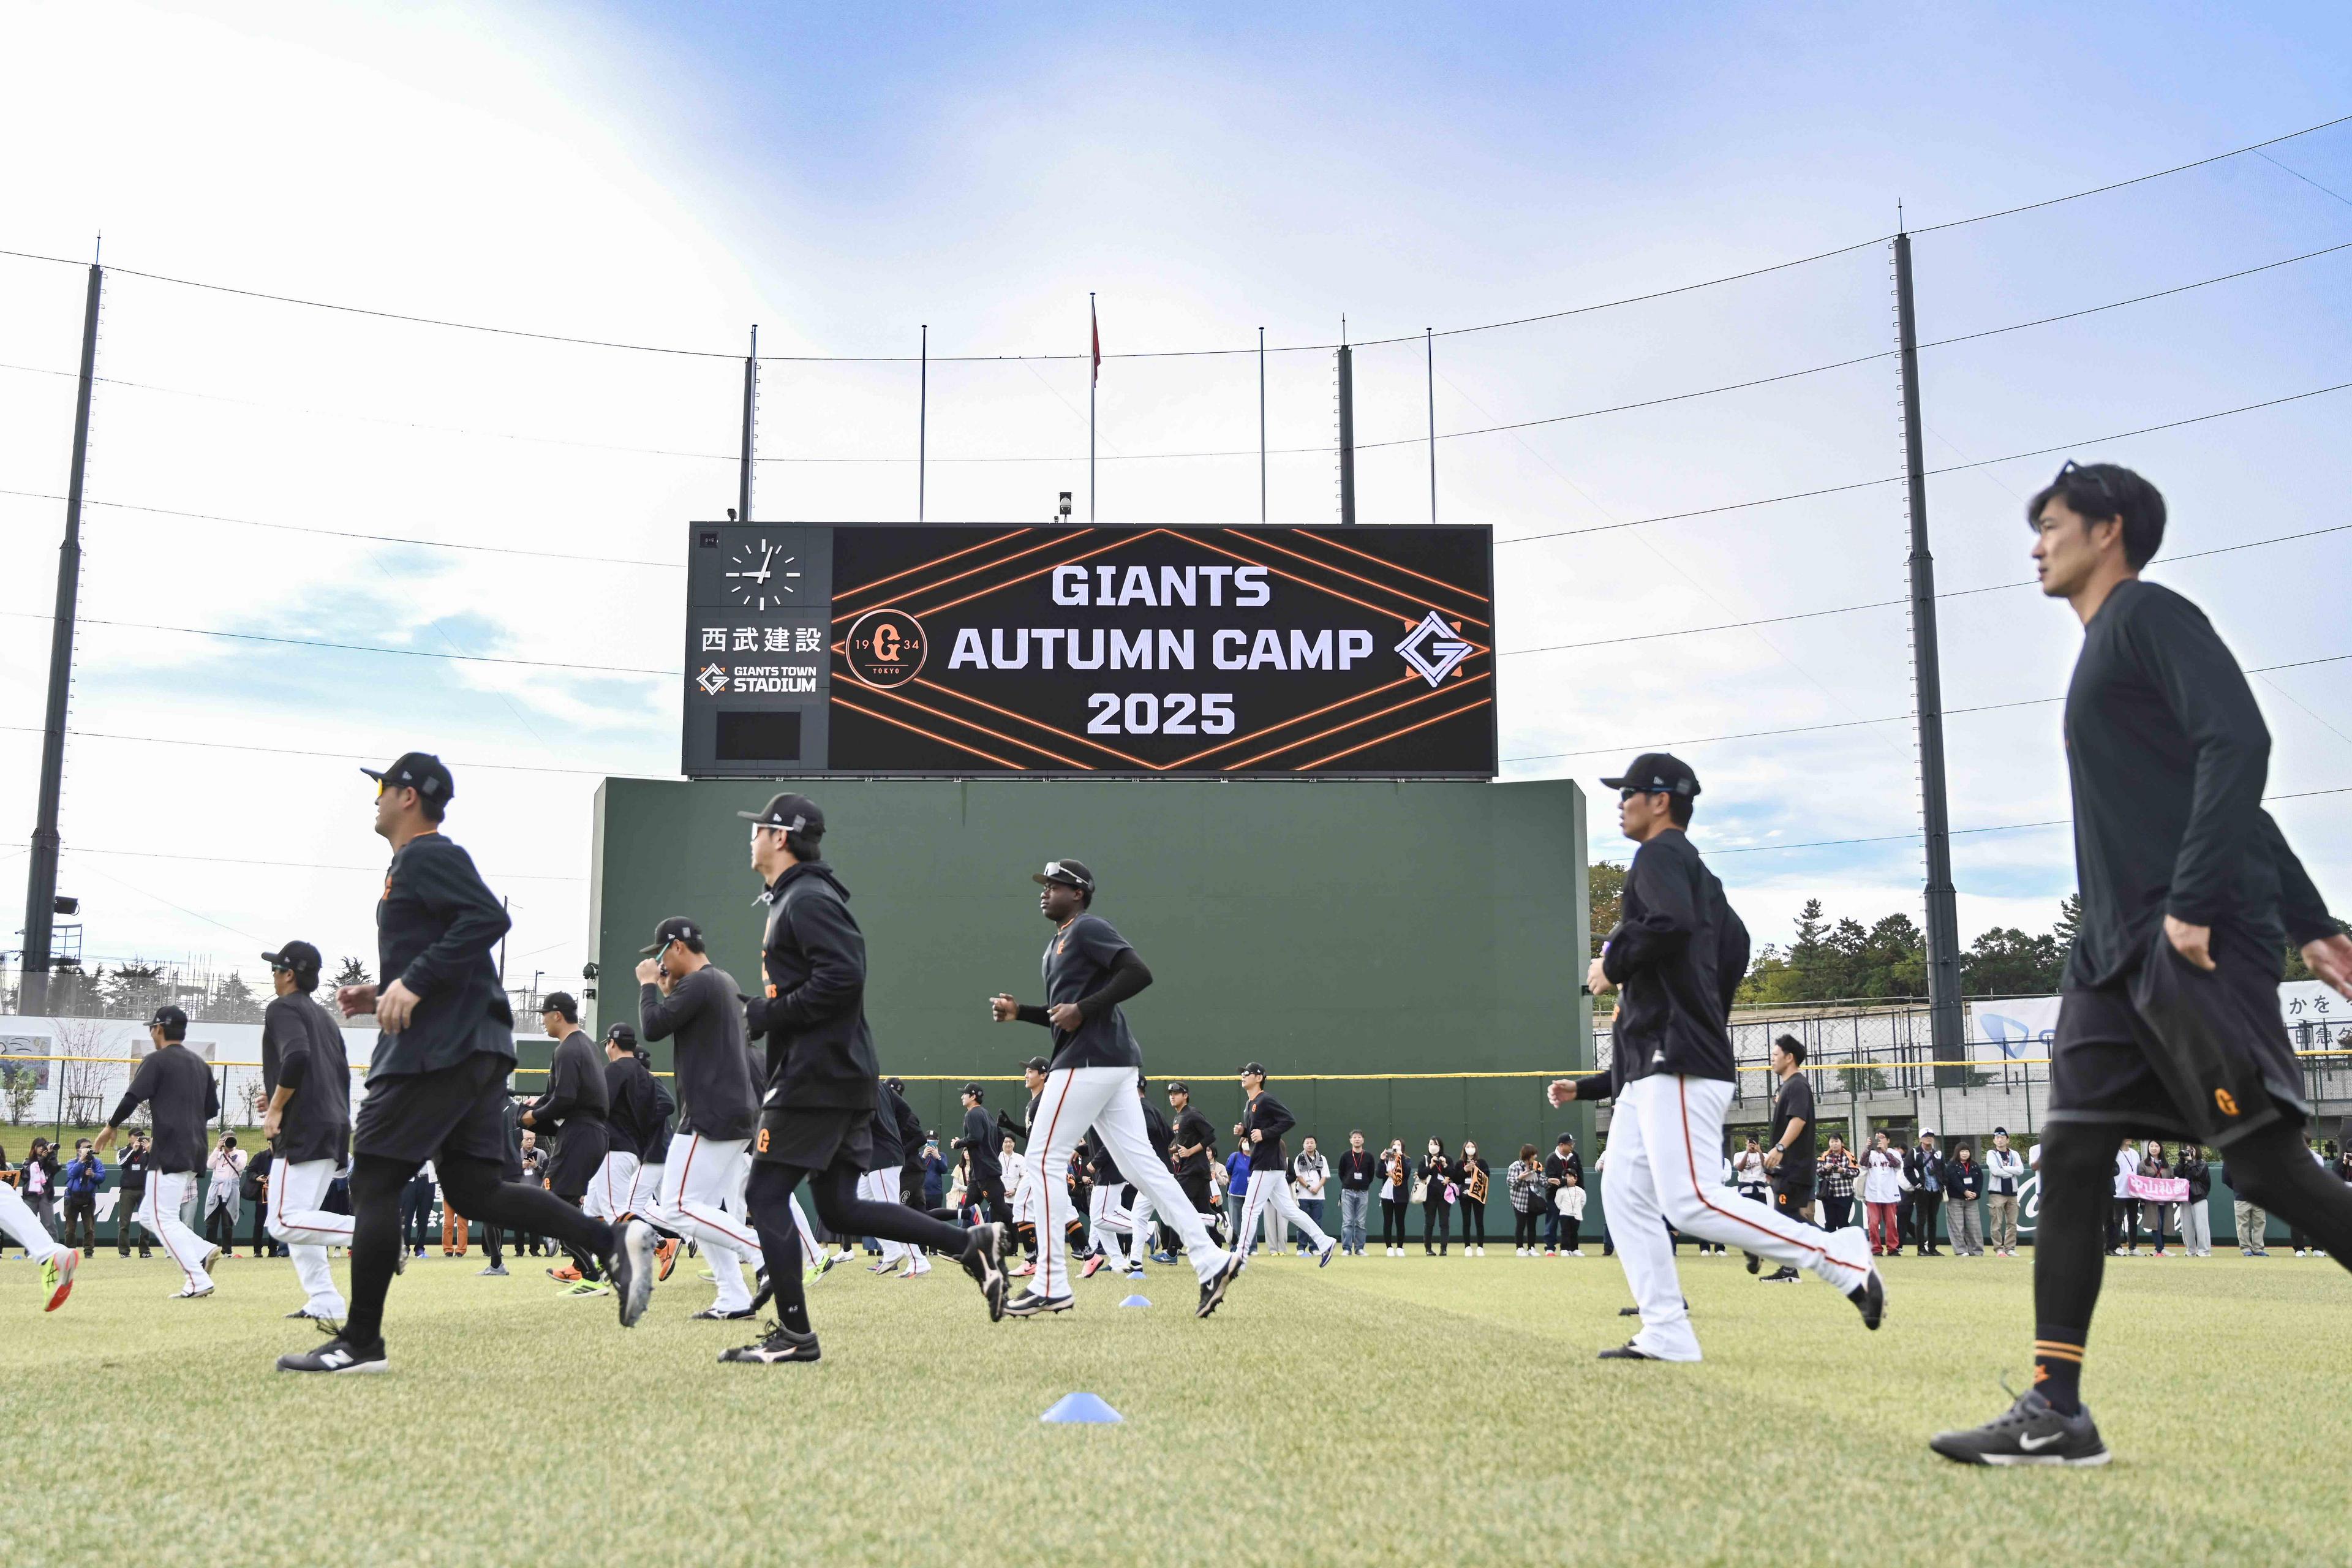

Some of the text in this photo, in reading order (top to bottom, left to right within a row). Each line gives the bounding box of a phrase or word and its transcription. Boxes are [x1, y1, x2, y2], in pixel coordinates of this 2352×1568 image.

[1052, 565, 1270, 606] GIANTS
[702, 627, 821, 652] 西武建設
[856, 640, 919, 649] 19 34
[872, 624, 900, 662] G
[948, 628, 1373, 671] AUTUMN CAMP
[734, 666, 816, 676] GIANTS TOWN
[734, 677, 816, 692] STADIUM
[1087, 693, 1235, 734] 2025
[2290, 995, 2352, 1015] かを
[757, 1128, 770, 1153] G
